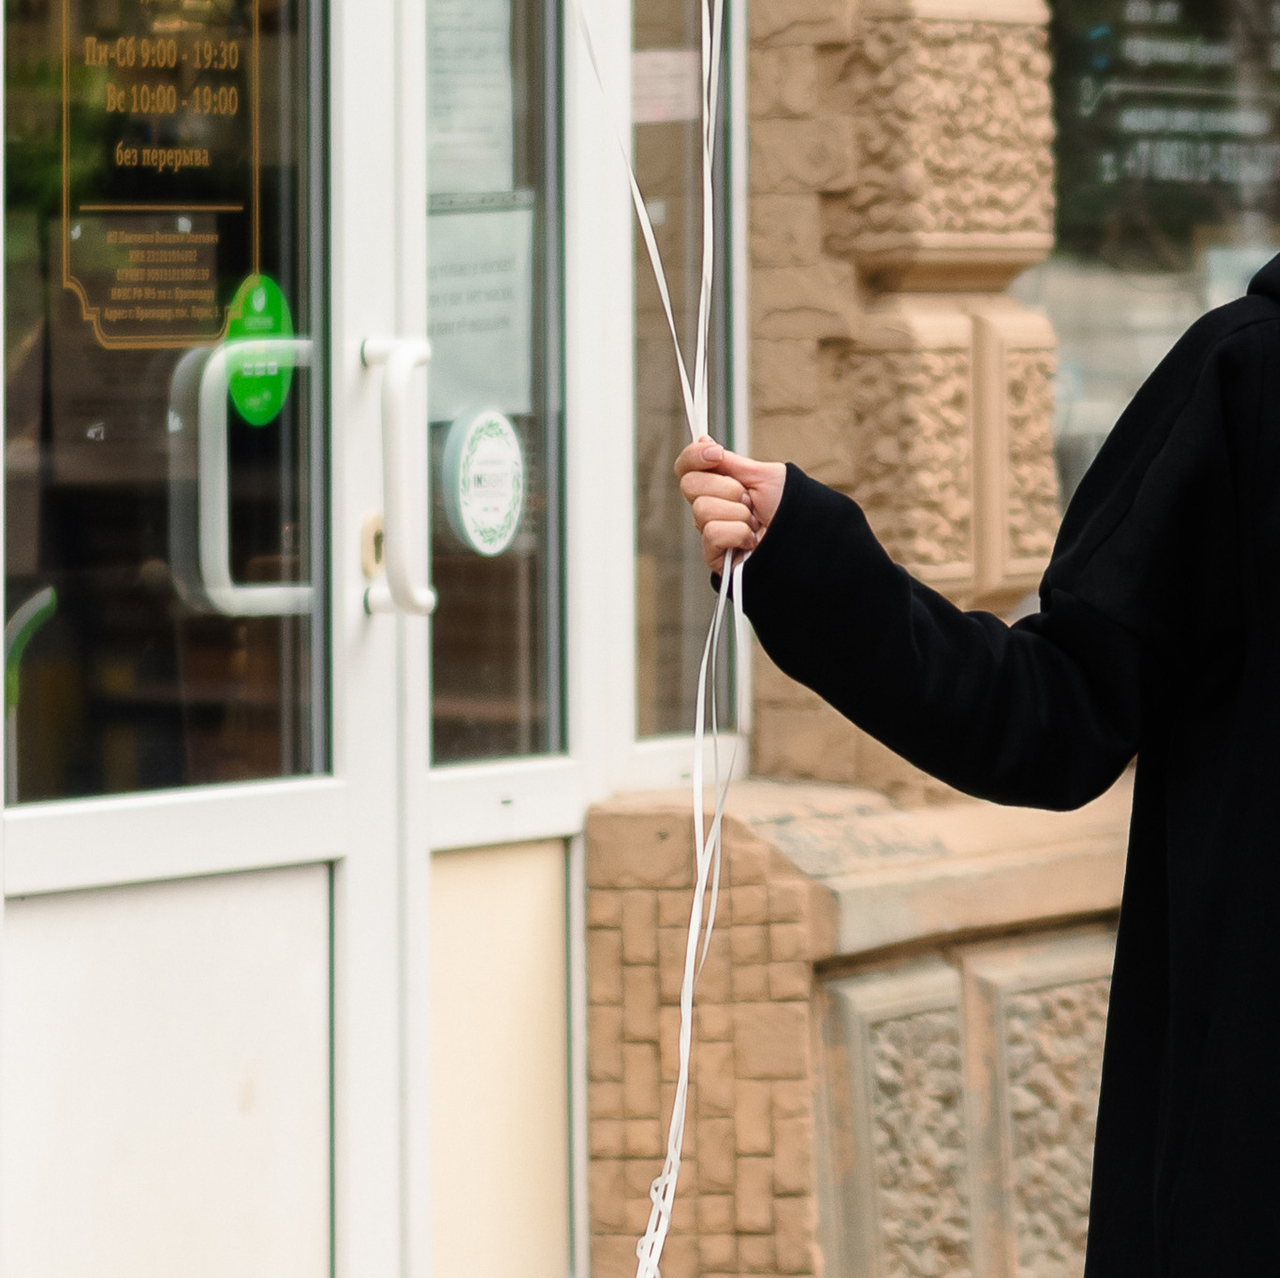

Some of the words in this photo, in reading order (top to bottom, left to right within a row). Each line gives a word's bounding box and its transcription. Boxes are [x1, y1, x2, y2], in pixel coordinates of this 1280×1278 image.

[84, 36, 136, 68] Пн-Сб
[140, 38, 178, 69] 9:00
[194, 40, 239, 70] 19:30
[106, 83, 126, 113] Вс
[131, 84, 177, 114] 10:00
[193, 85, 239, 116] 19:00
[116, 140, 139, 167] без
[142, 148, 210, 173] перерыва
